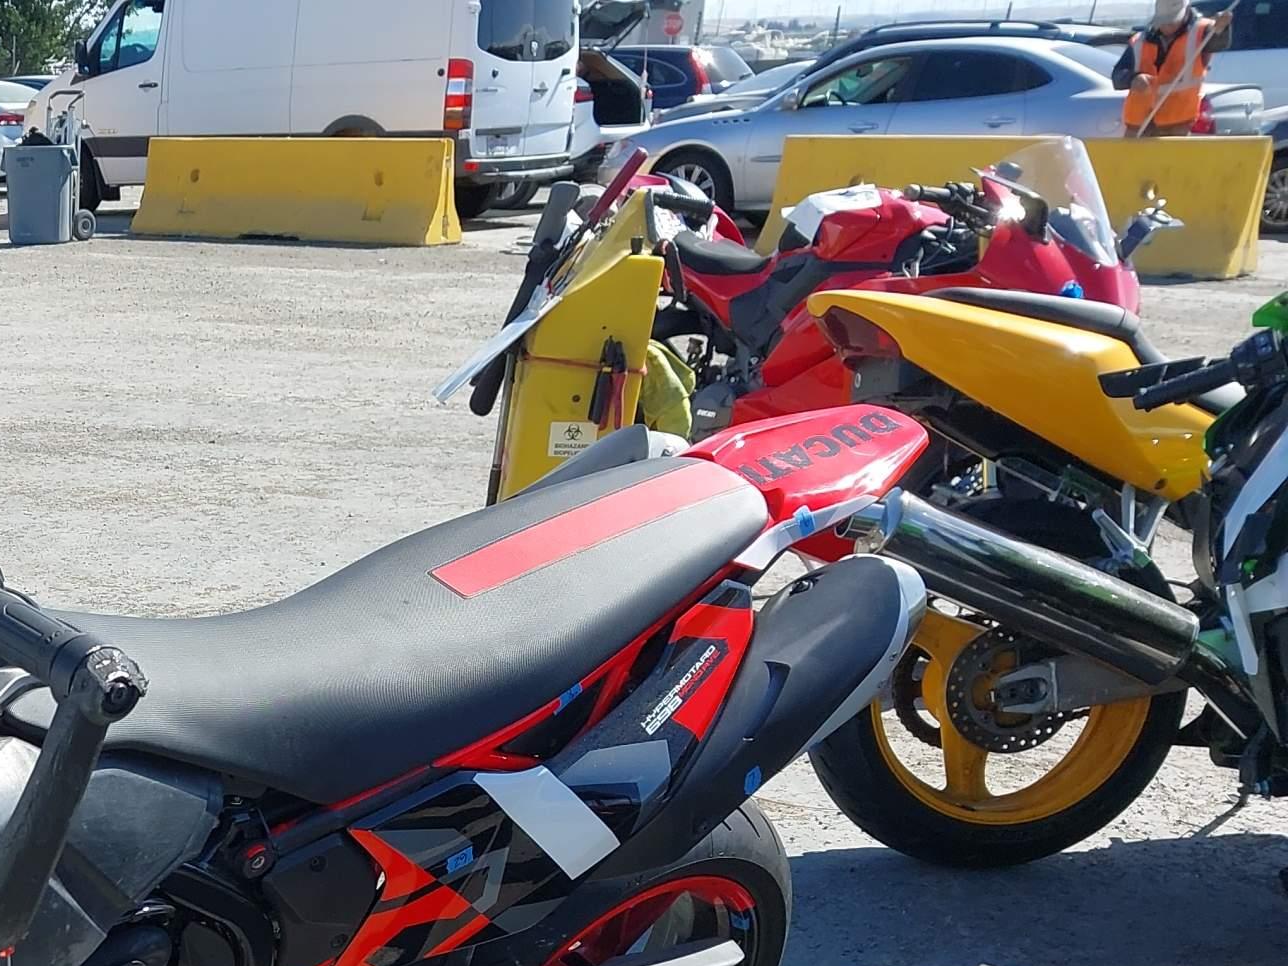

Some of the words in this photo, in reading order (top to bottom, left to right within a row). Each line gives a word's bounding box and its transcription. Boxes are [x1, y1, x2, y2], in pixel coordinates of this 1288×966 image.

[739, 411, 903, 485] DUCATI
[640, 644, 716, 728] HYPERMOTARD
[645, 696, 682, 736] 698
